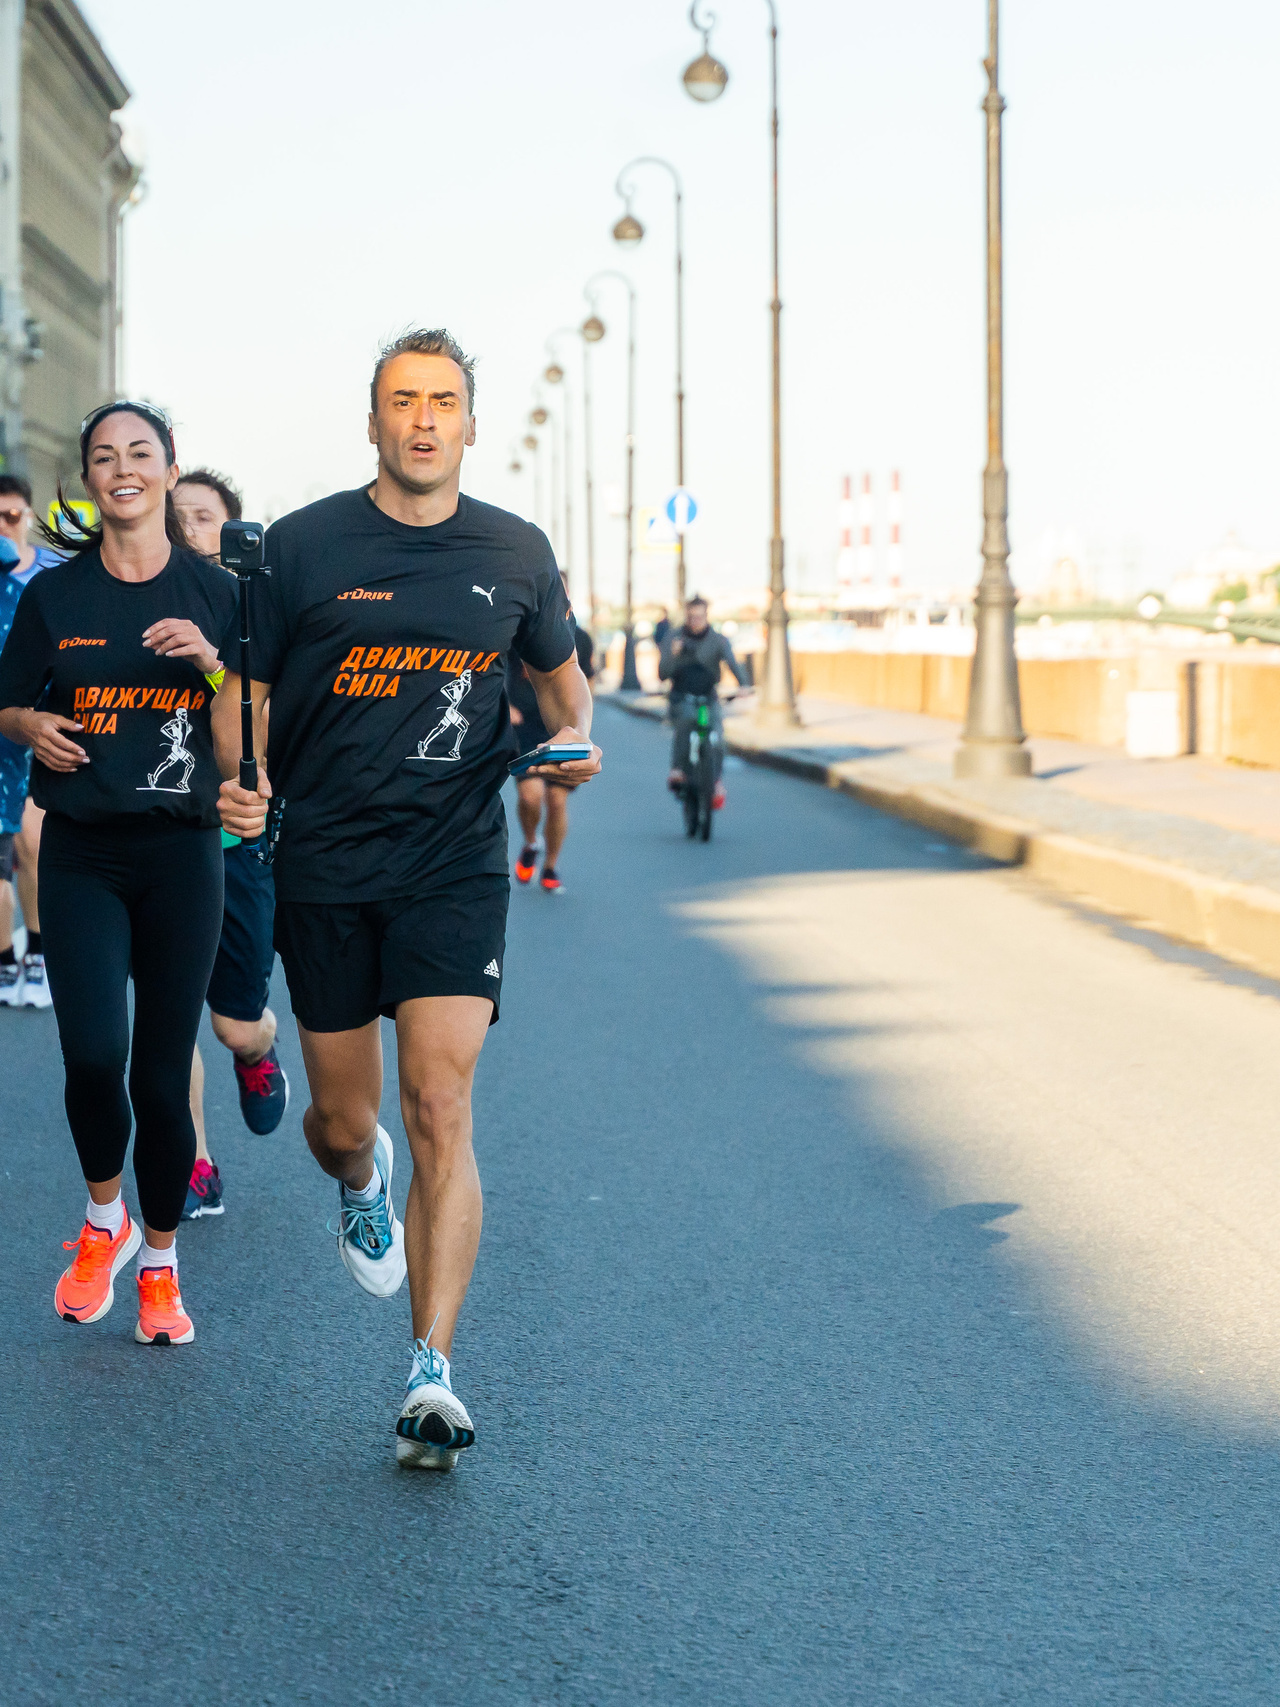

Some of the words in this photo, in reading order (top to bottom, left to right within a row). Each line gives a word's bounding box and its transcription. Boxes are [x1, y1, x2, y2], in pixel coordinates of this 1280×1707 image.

[339, 646, 500, 677] ДВИЖУЩАЯ
[332, 673, 401, 698] СИЛА
[73, 686, 206, 713] ДВИЖУЩАЯ
